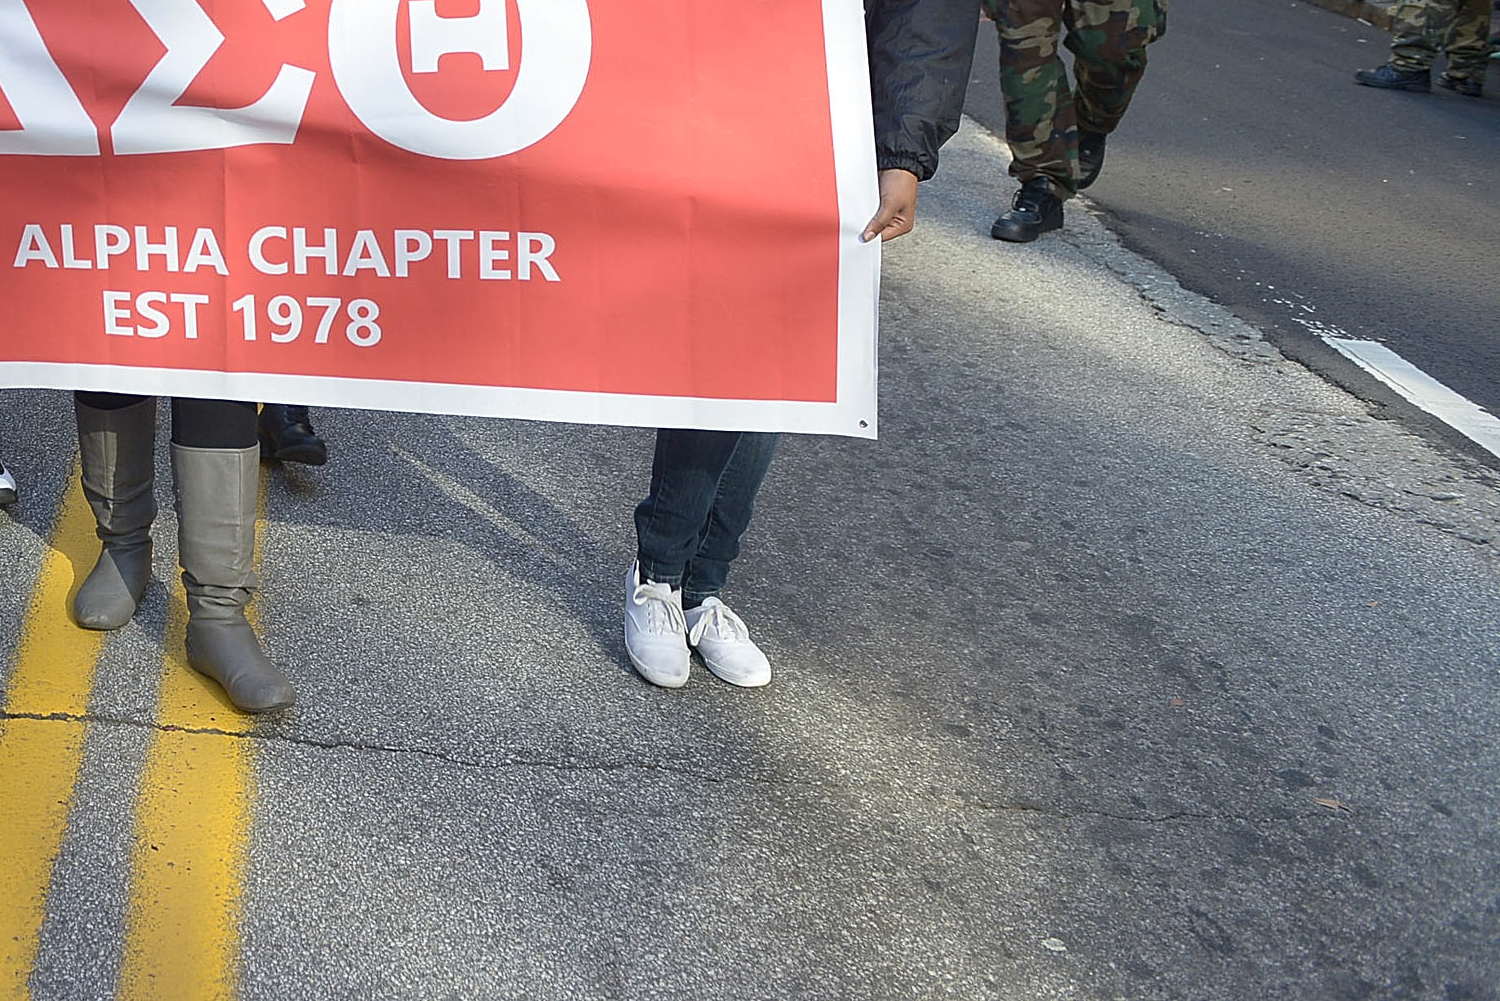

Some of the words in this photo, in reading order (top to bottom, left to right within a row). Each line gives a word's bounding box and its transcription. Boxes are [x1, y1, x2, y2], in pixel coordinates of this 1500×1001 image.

[14, 224, 229, 277] ALPHA
[247, 226, 562, 283] CHAPTER
[102, 290, 209, 341] EST
[231, 295, 382, 348] 1978
